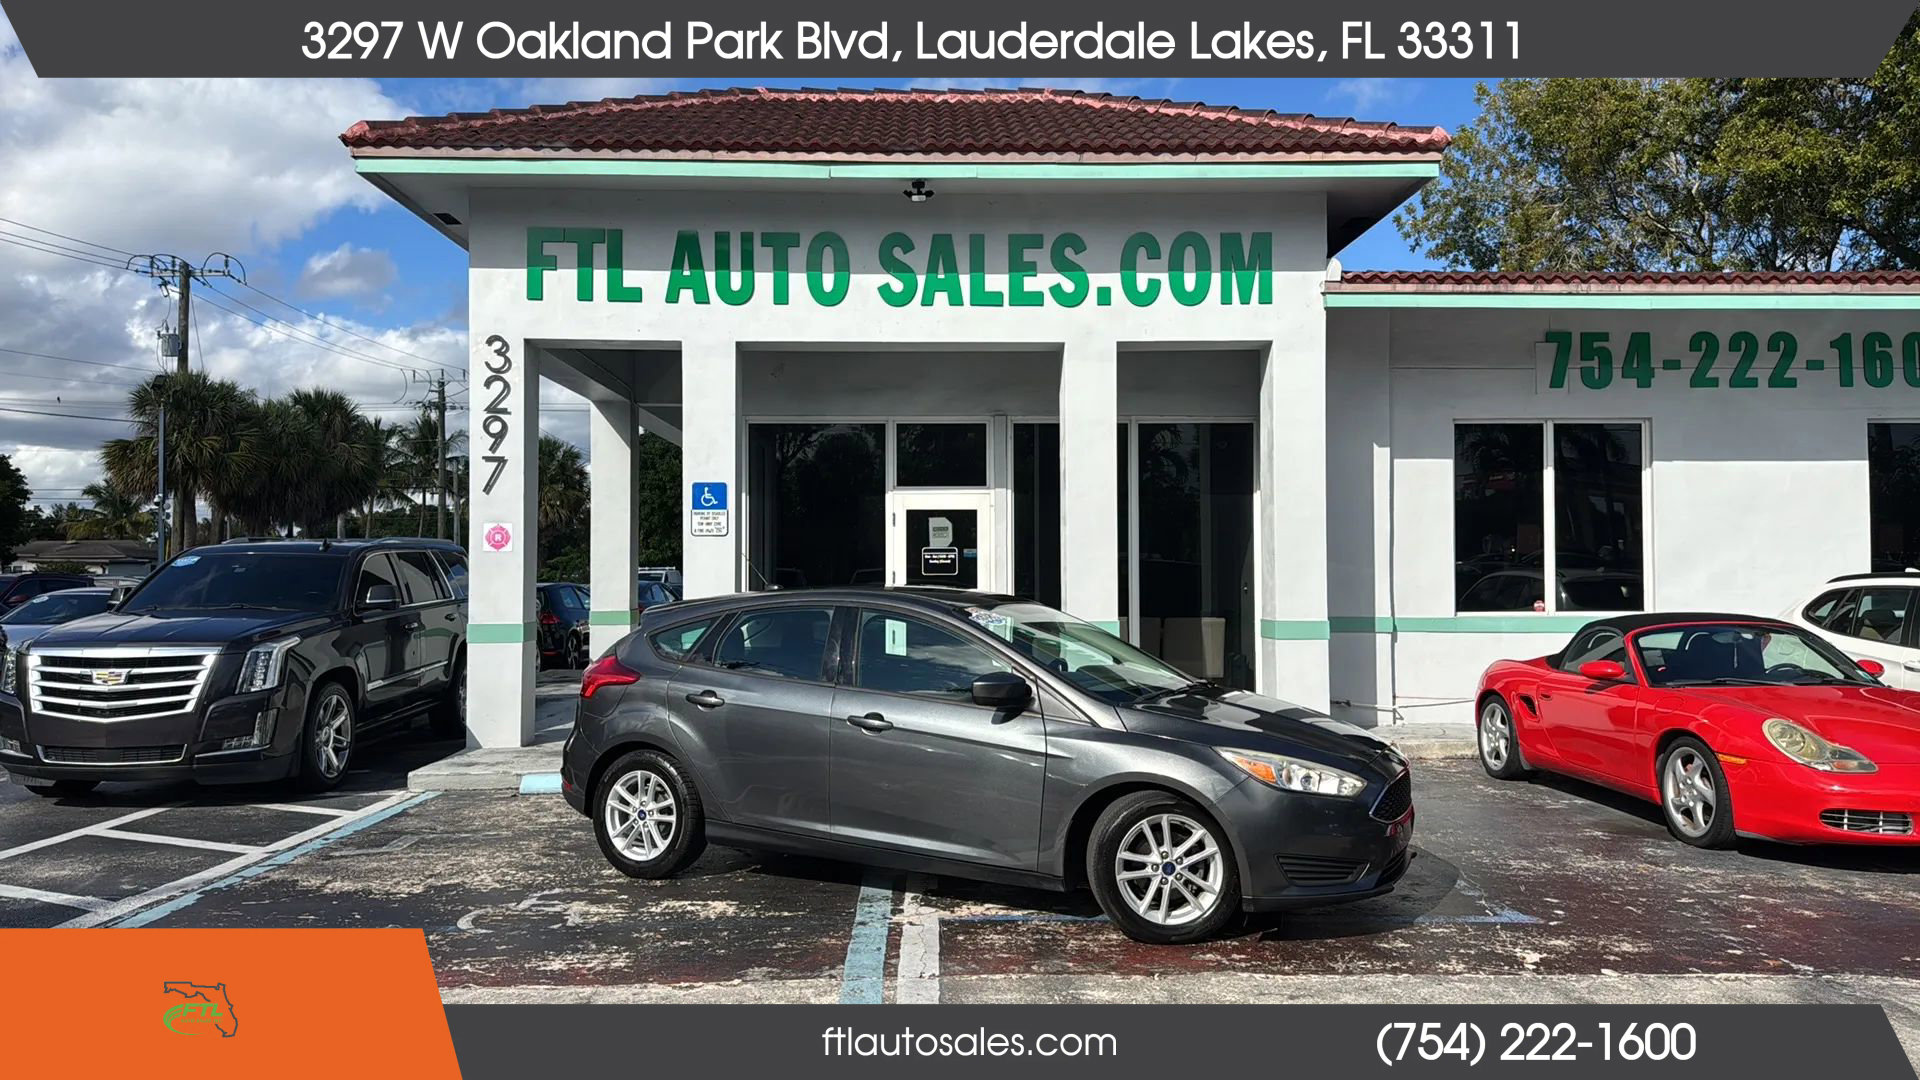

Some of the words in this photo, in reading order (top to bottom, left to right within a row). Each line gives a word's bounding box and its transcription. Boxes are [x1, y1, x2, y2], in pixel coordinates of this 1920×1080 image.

[526, 228, 643, 303] FTL
[665, 231, 851, 307] AUTO
[877, 232, 1274, 308] SALES.COM
[482, 334, 512, 496] 3297
